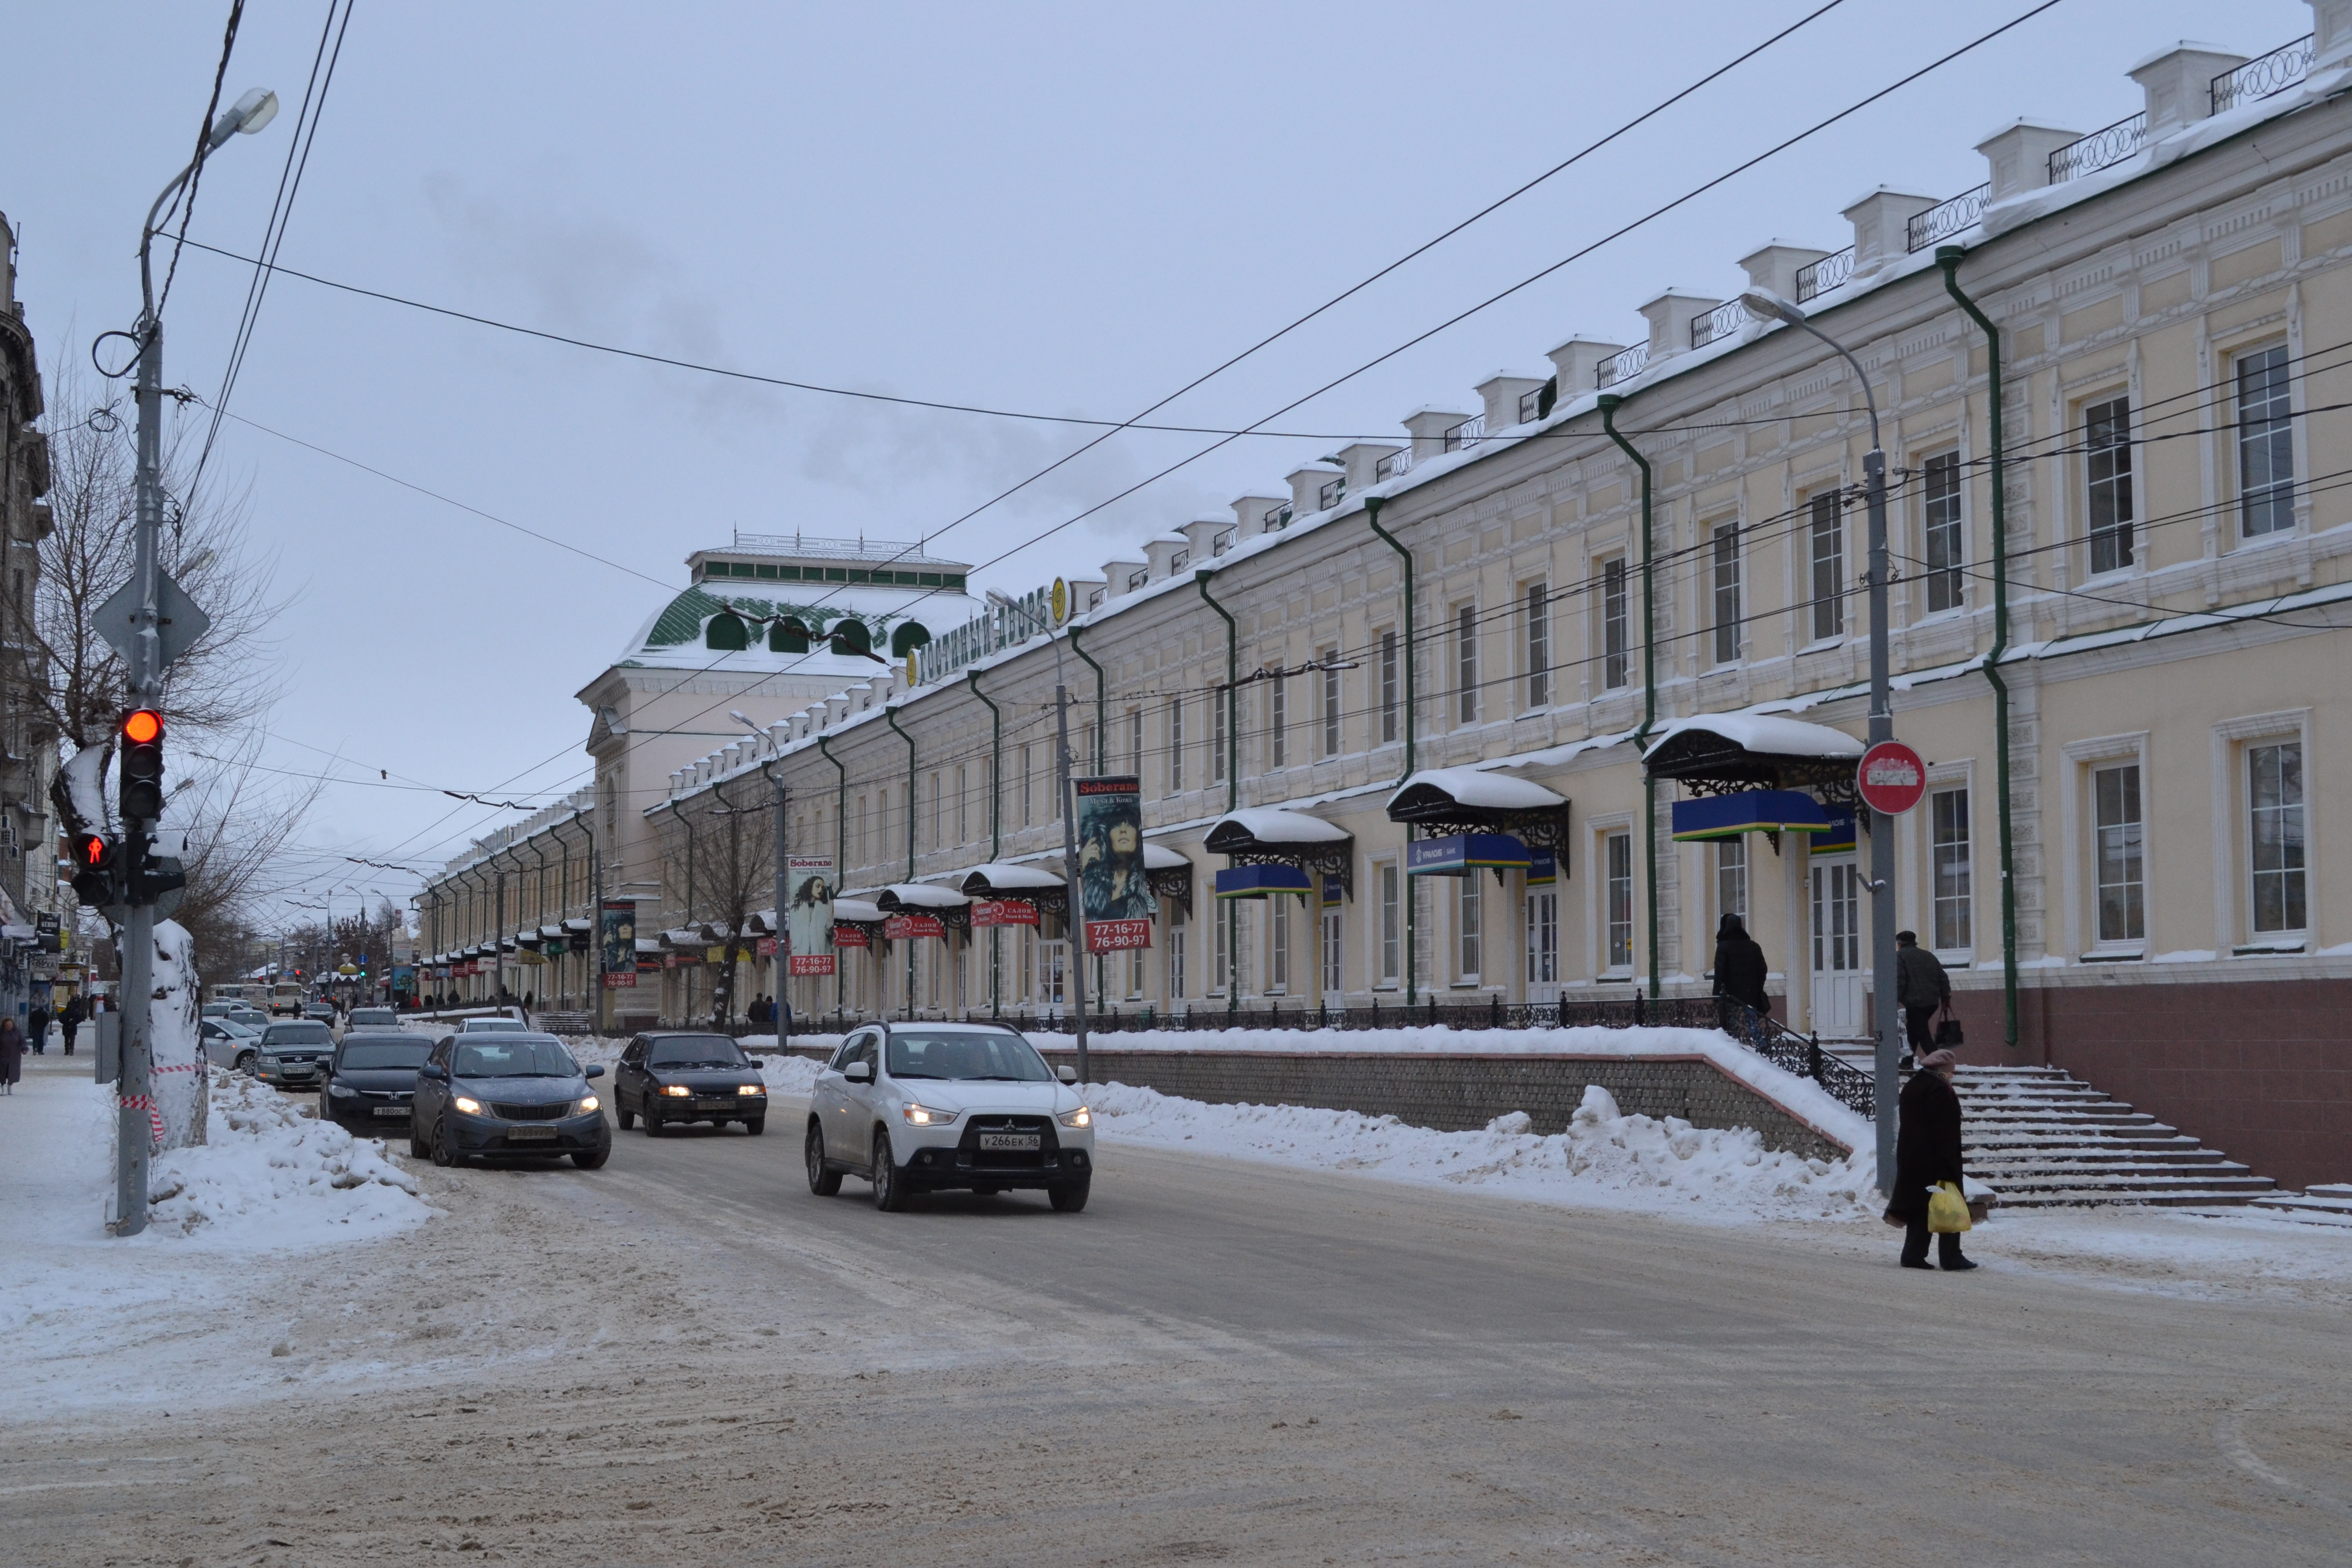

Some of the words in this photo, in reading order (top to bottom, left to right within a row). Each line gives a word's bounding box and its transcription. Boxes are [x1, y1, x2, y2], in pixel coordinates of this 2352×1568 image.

[920, 604, 991, 682] ГОСТИНЫЙ
[997, 586, 1047, 650] ДВОРЪ
[1080, 782, 1138, 793] Soberano
[1423, 849, 1442, 859] УРАЛСИБ
[1094, 923, 1144, 936] 77-16-77
[1094, 935, 1145, 947] 76-90-97
[796, 965, 831, 973] 76-90-97
[984, 1136, 1023, 1146] У266ЕК
[1028, 1136, 1038, 1144] 56
